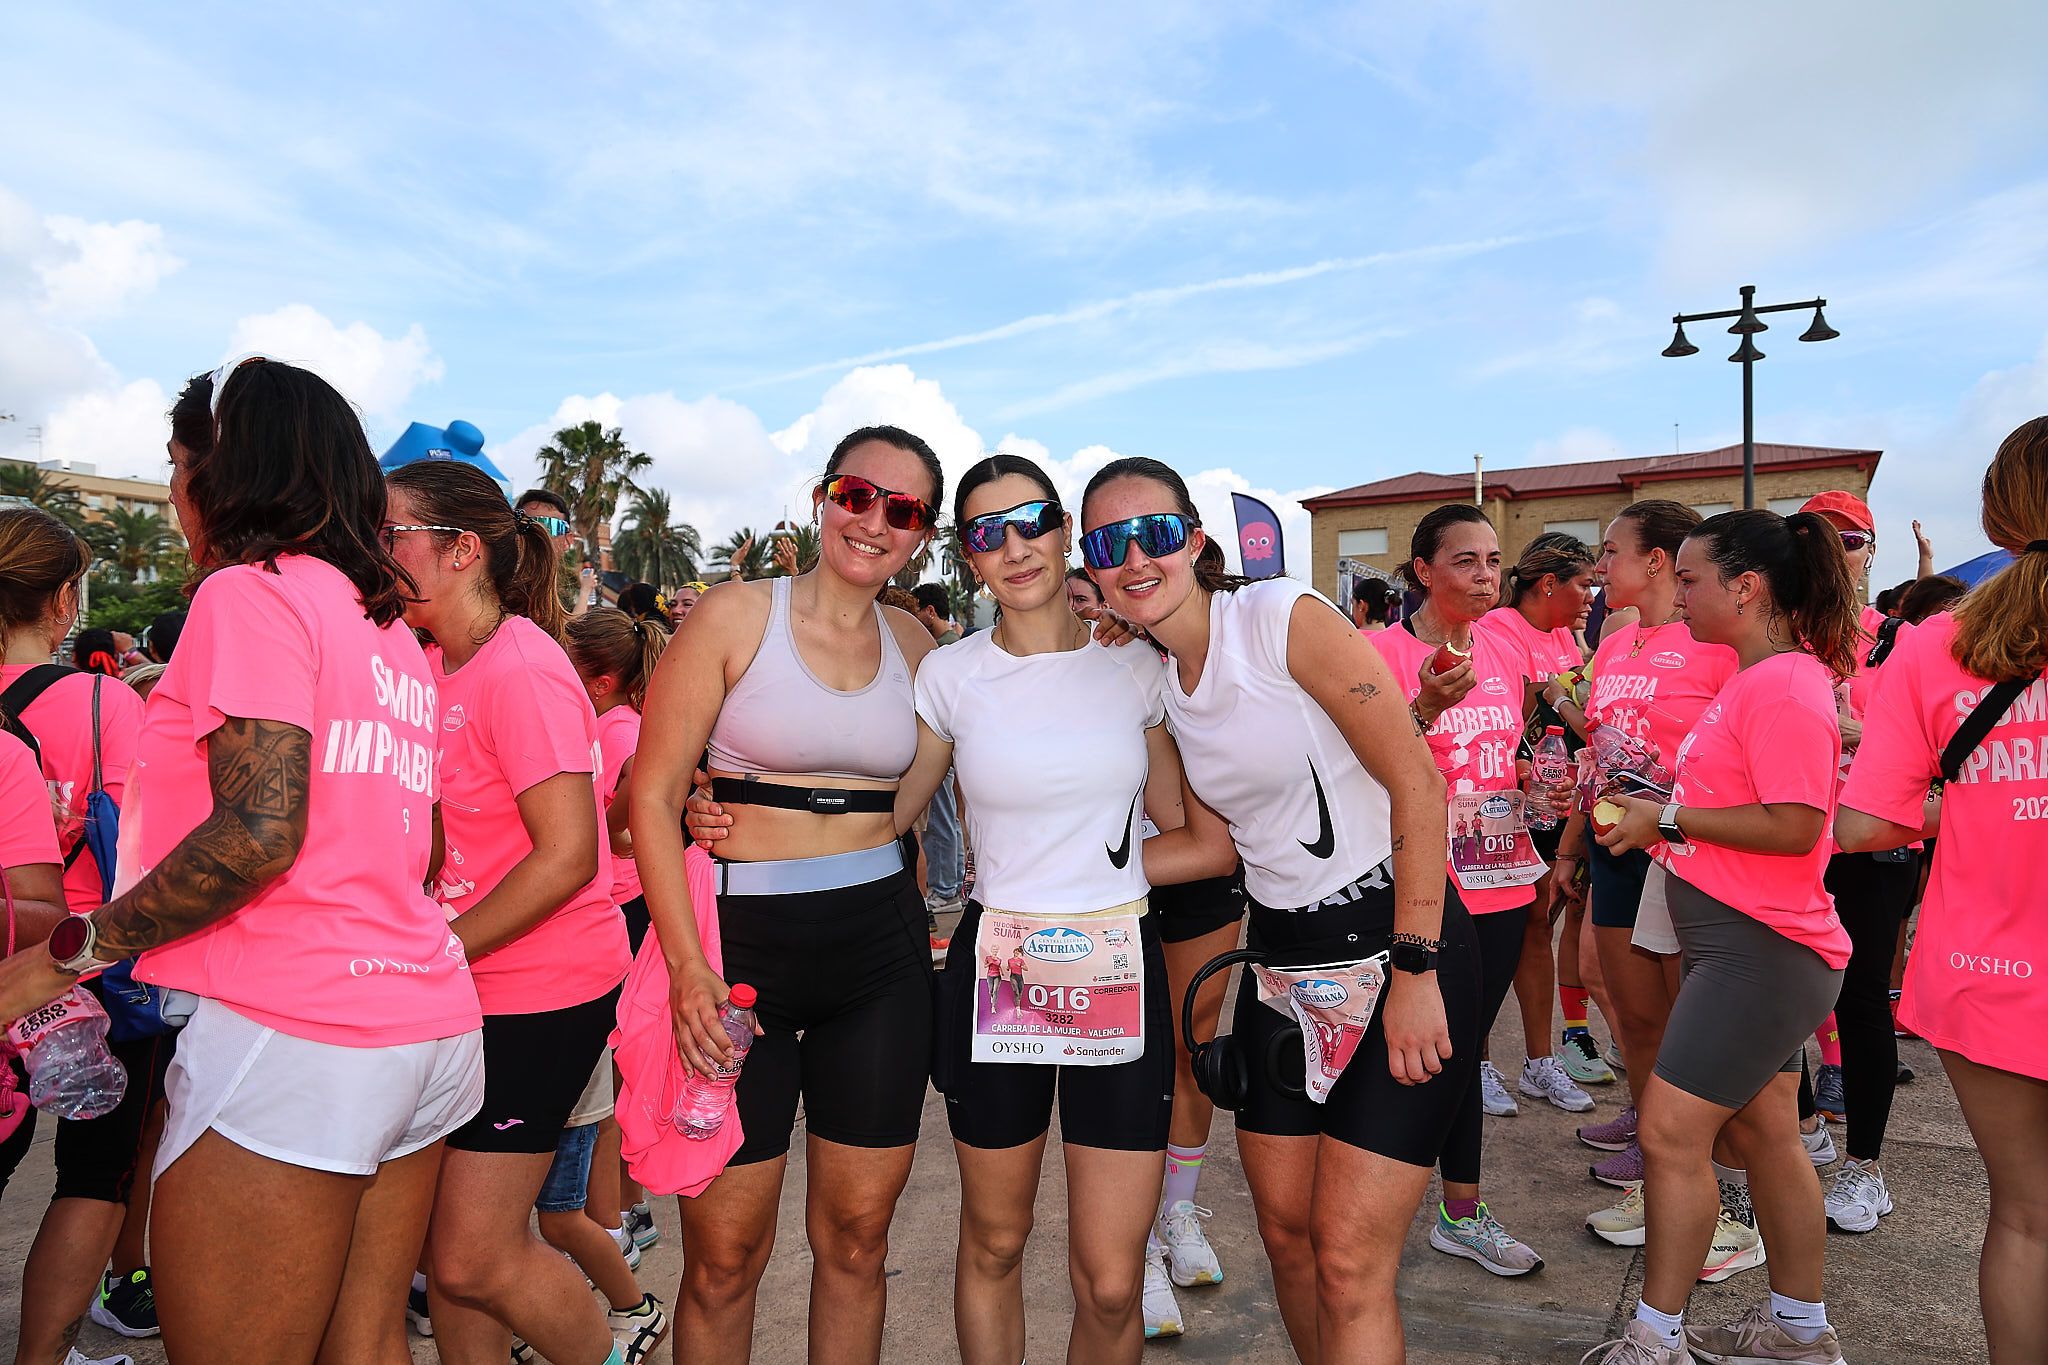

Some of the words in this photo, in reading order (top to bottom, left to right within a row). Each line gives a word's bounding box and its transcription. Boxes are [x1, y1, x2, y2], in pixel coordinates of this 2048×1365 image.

[371, 655, 435, 733] SMOS
[1484, 834, 1515, 852] 016
[994, 927, 1021, 939] SUMA
[1028, 939, 1089, 953] ASTURIANA
[1950, 952, 2032, 978] OYSHO
[1029, 985, 1091, 1010] 016
[1094, 986, 1137, 994] CORREDORA
[1294, 989, 1345, 1002] ASTURIANA
[18, 1003, 63, 1034] ZERO
[21, 1009, 68, 1040] SODIO
[1045, 1013, 1074, 1024] 3282
[991, 1024, 1028, 1033] CARRERA
[1042, 1025, 1052, 1034] LA
[1054, 1026, 1081, 1035] MUJER
[1088, 1027, 1125, 1037] VALENCIA
[1301, 1014, 1317, 1062] OYSHO
[992, 1041, 1044, 1055] OYSHO
[1076, 1046, 1125, 1057] Santander
